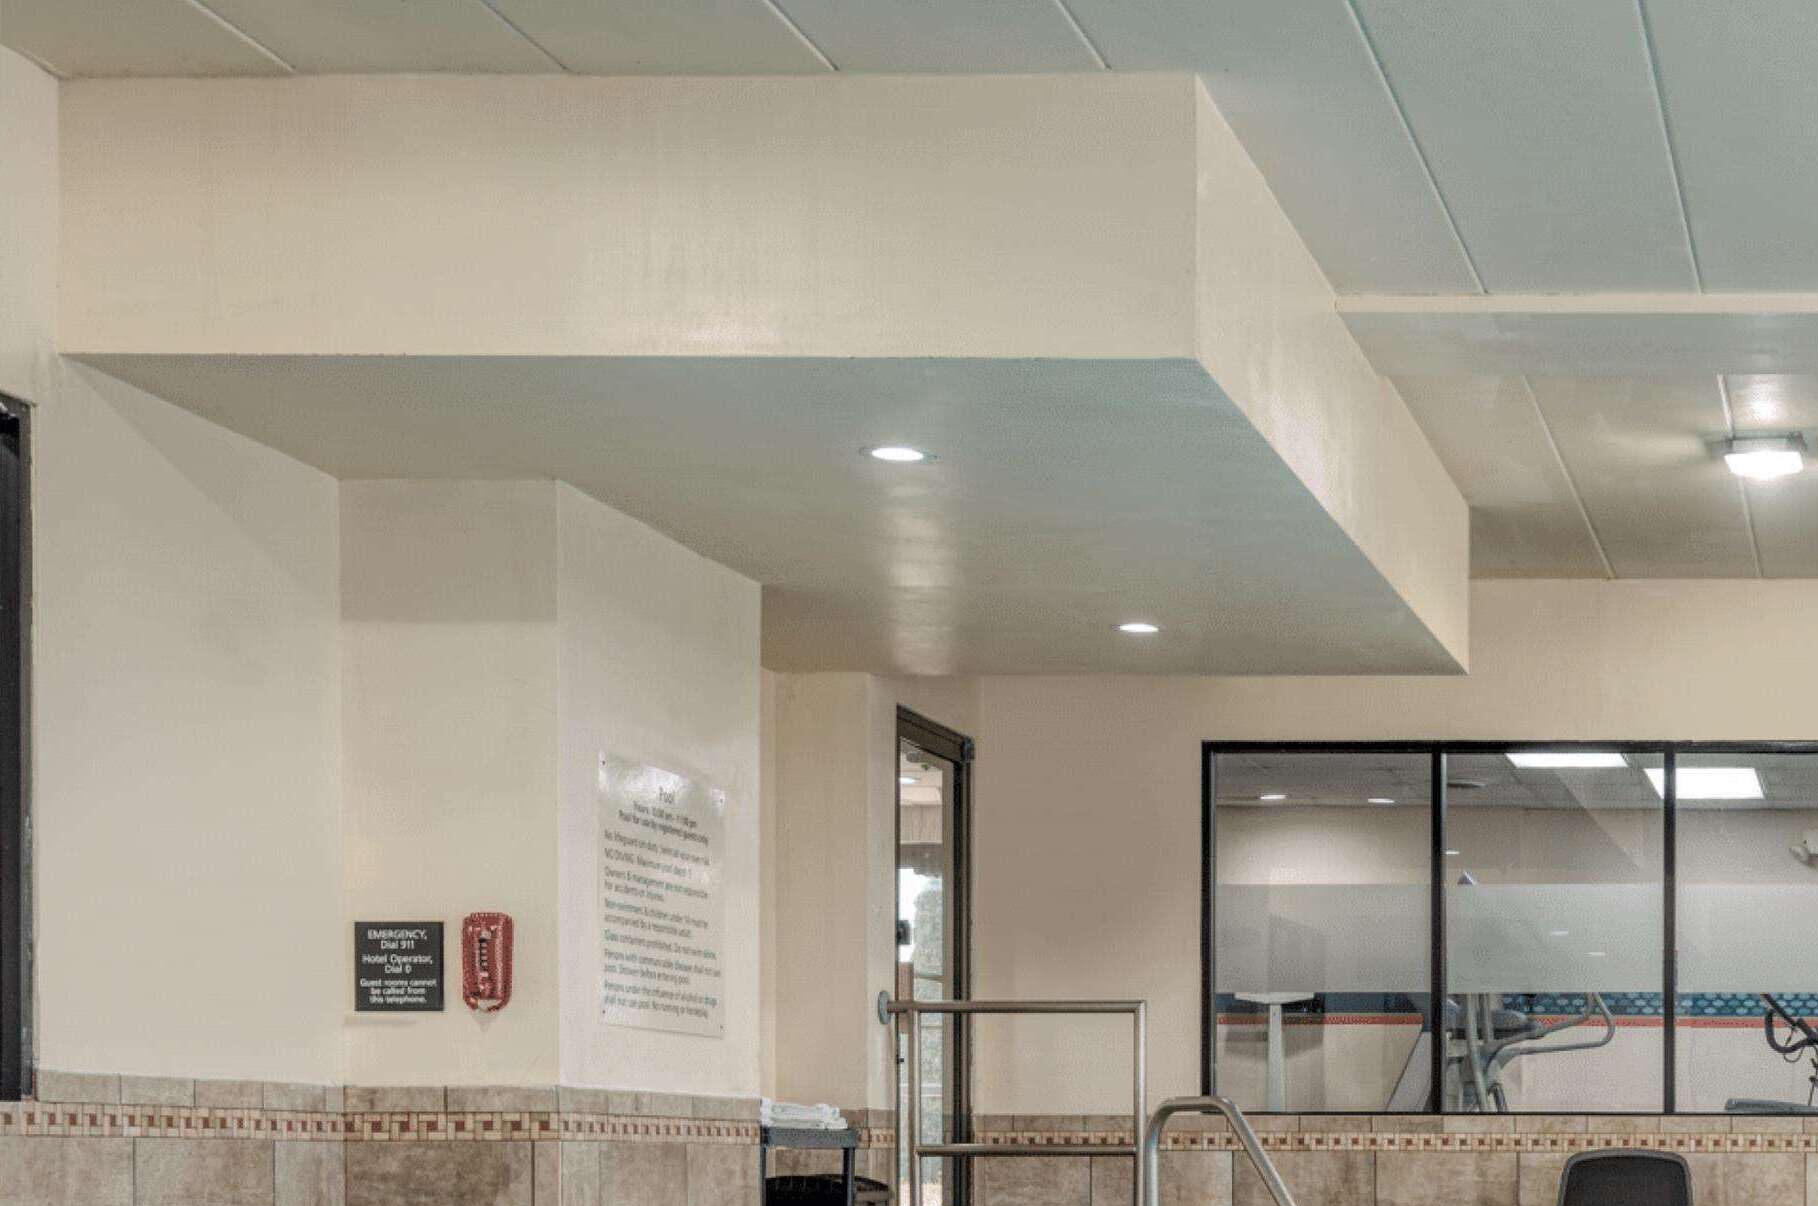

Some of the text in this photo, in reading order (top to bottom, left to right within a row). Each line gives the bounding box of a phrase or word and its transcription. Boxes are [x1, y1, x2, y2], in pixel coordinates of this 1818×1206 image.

[381, 940, 415, 949] Dial 911
[362, 954, 387, 964] Hotel
